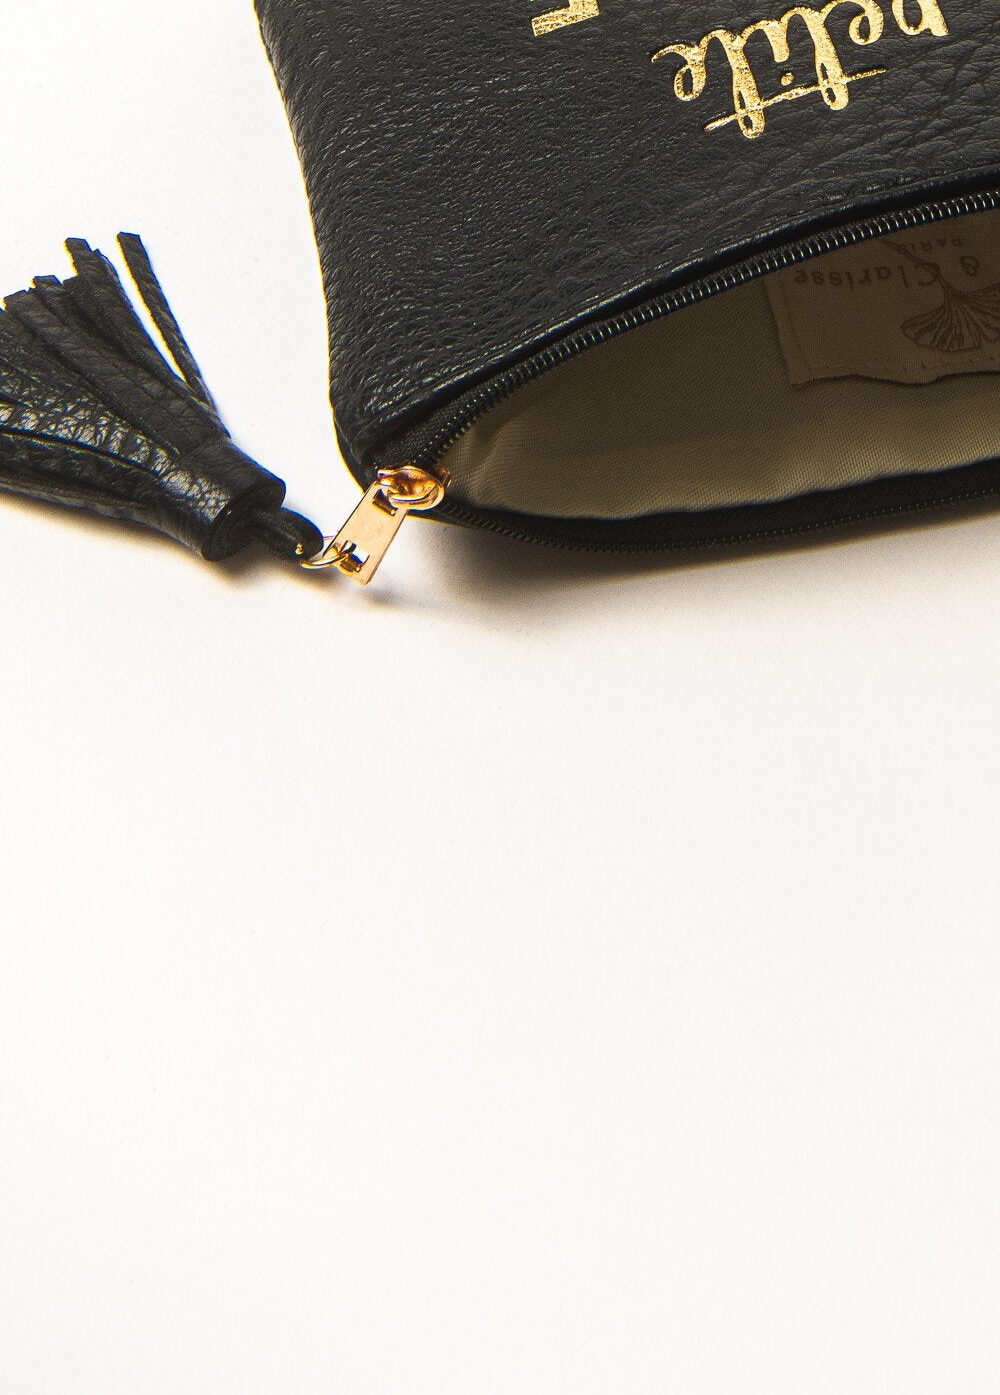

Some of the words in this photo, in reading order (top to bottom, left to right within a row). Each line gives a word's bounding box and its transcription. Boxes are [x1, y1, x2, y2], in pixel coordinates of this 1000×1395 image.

[897, 237, 962, 255] PARIS
[793, 263, 941, 291] Clarisse
[959, 256, 981, 277] &
